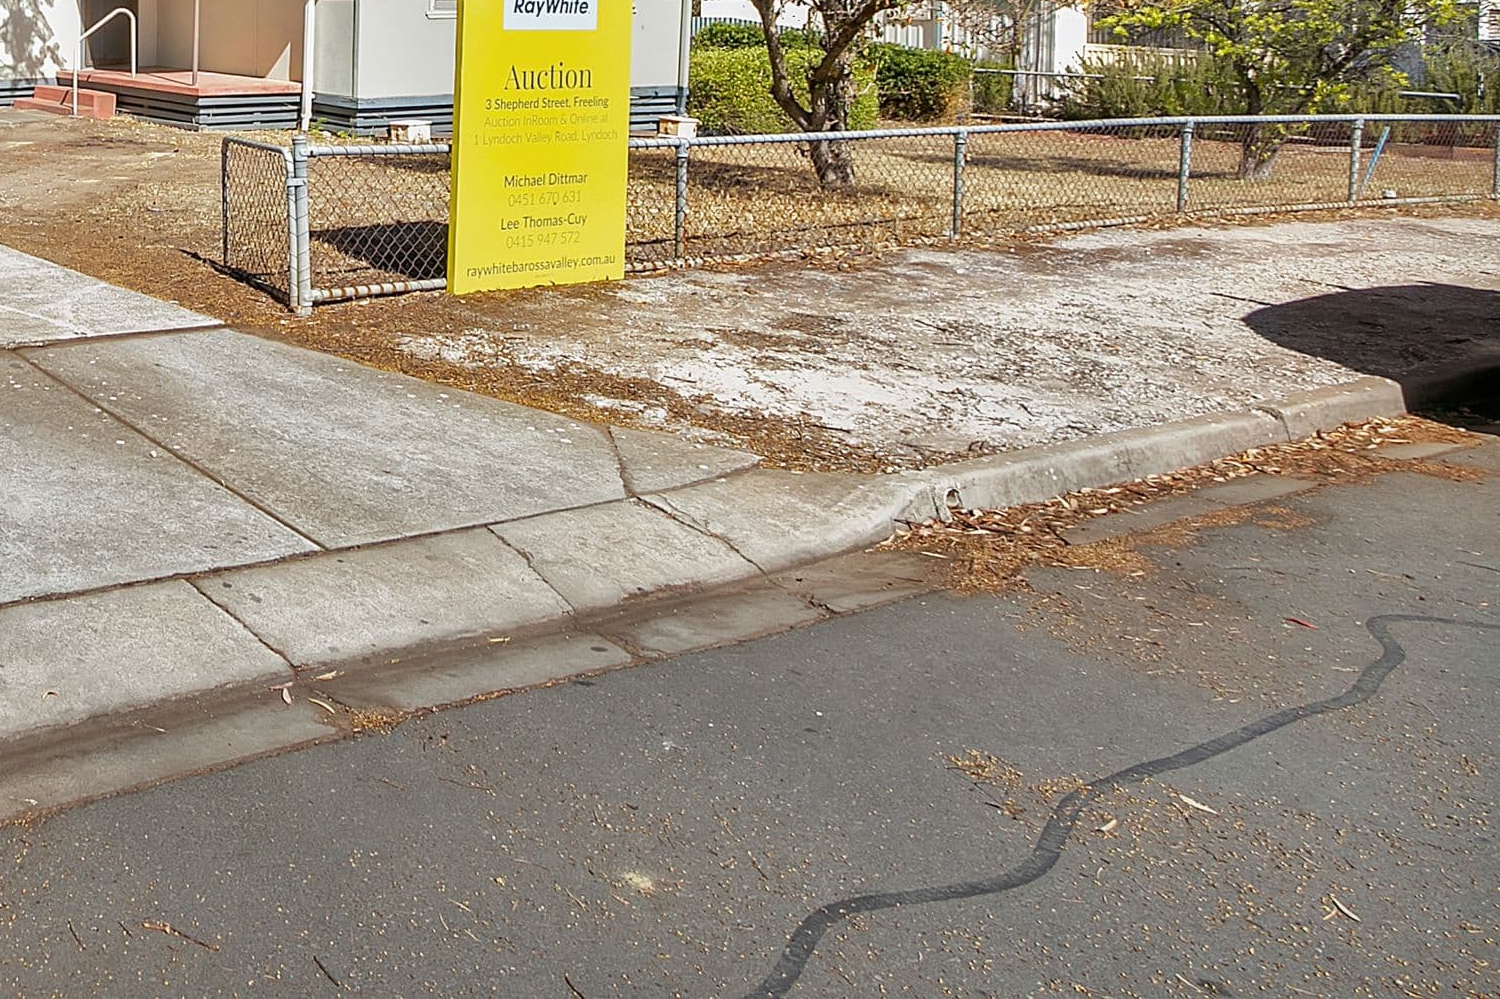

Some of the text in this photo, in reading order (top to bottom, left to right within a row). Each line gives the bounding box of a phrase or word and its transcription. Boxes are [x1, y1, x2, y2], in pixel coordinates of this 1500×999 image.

[504, 61, 592, 90] Auction
[485, 98, 492, 110] 3
[494, 97, 540, 111] Shepherd
[573, 95, 610, 108] Freeling
[484, 116, 521, 128] Auction
[482, 131, 522, 147] Lyndoch
[581, 129, 618, 144] Lyndoch
[504, 172, 588, 188] Michael Dittmar
[508, 190, 581, 207] 0451 670 631
[500, 212, 588, 230] Lee Thomas-Cuy
[506, 231, 581, 249] 0415 947 572
[466, 254, 616, 278] raywhitebarossavalley.com.au
